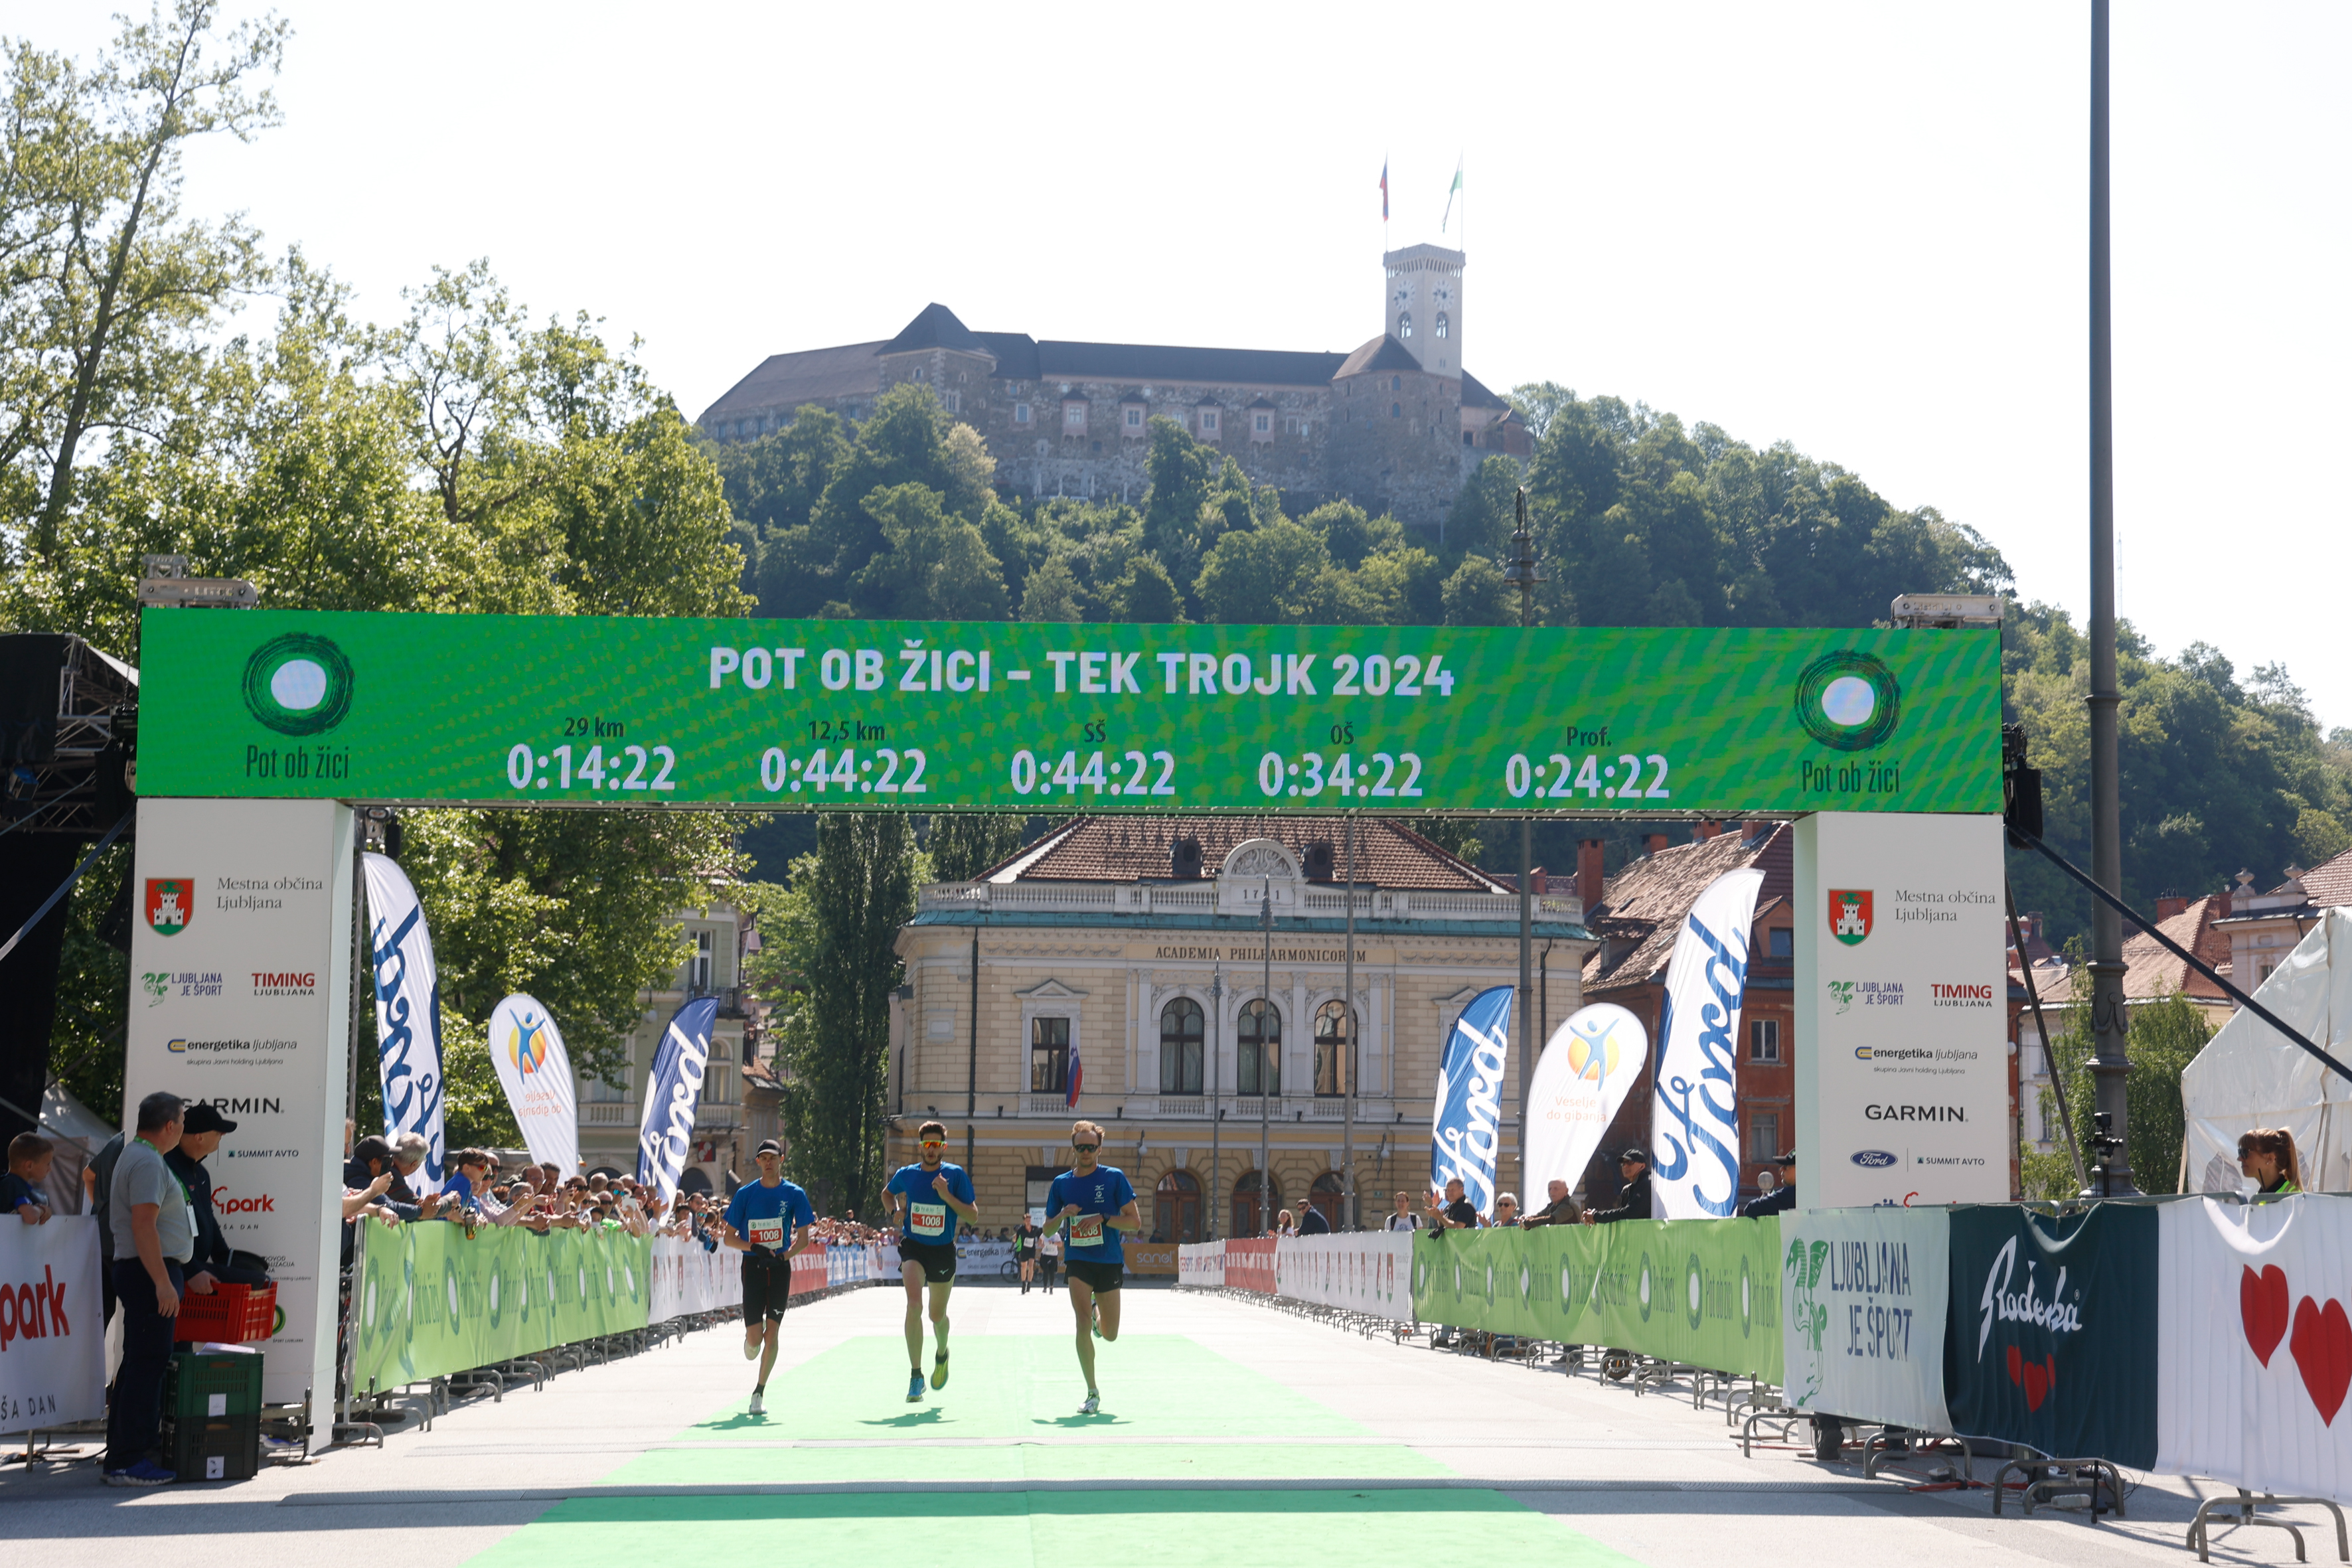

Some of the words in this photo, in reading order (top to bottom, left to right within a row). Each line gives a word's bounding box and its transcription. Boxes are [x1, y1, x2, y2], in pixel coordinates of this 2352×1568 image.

[710, 647, 805, 690] POT
[821, 648, 885, 691] OB
[900, 639, 990, 692] ŽICI
[1046, 651, 1141, 694] TEK
[1156, 652, 1317, 696] TROJK
[1333, 654, 1454, 696] 2024
[564, 718, 589, 738] 29
[595, 718, 624, 738] km
[808, 720, 850, 742] 12,5
[856, 721, 885, 742] km
[1084, 720, 1107, 743] SŠ
[1330, 722, 1354, 745] OŠ
[1567, 726, 1612, 747] Prof.
[246, 745, 277, 778] Pot
[285, 745, 308, 779] ob
[316, 746, 349, 779] žici
[507, 744, 675, 790] 0:14:22
[761, 747, 927, 793] 0:44:22
[1011, 749, 1175, 795] 0:44:22
[1259, 751, 1422, 797] 0:34:22
[1506, 753, 1670, 799] 0:24:22
[1802, 760, 1832, 793] Pot
[1838, 761, 1860, 793] ob
[1868, 761, 1900, 793] žici
[217, 877, 269, 891] Mestna
[274, 876, 323, 891] občina
[1243, 889, 1279, 900] 171
[1895, 890, 1944, 903] Mestna
[1948, 890, 1996, 904] občina
[217, 896, 283, 912] Ljubljana
[1895, 908, 1958, 924] Ljubljana
[1155, 947, 1221, 959] ACADEMIA
[1230, 948, 1366, 962] PHILHARMONICORM
[171, 973, 223, 984] LJUBLJANA
[251, 973, 315, 988] TIMING
[181, 985, 191, 996] JE
[193, 982, 223, 996] ŠPORT
[1856, 981, 1904, 994] LJUBLJANA
[1930, 984, 1992, 999] TIMING
[1865, 994, 1875, 1005] JE
[1877, 991, 1904, 1006] ŠPORT
[187, 1039, 250, 1052] energetika
[252, 1039, 297, 1052] ljubljana
[1873, 1048, 1932, 1060] energetika
[1934, 1050, 1978, 1061] ljubljana
[1652, 913, 1751, 1217] Ford
[1915, 1067, 1937, 1075] holding
[1938, 1067, 1965, 1075] Ljubljana
[1555, 1095, 1597, 1109] Veselje
[1434, 1018, 1508, 1225] Ford
[1546, 1109, 1561, 1121] do
[1564, 1110, 1607, 1123] gibanja
[1865, 1104, 1964, 1123] GARMIN
[275, 1149, 299, 1158] AVTO
[1859, 1152, 1889, 1166] Ford
[1926, 1157, 1960, 1166] SUMMIT
[1962, 1158, 1985, 1166] AVTO
[226, 1194, 275, 1215] park
[921, 1215, 941, 1227] 1008
[759, 1229, 779, 1241] 1008
[1077, 1226, 1099, 1237] 108
[1830, 1241, 1912, 1296] LJUBLJANA
[1705, 1268, 1715, 1318] Pot
[1716, 1269, 1723, 1319] ob
[0, 1264, 70, 1352] park
[1847, 1304, 1863, 1357] JE
[1867, 1296, 1913, 1362] ŠPORT
[28, 1393, 56, 1417] DAN
